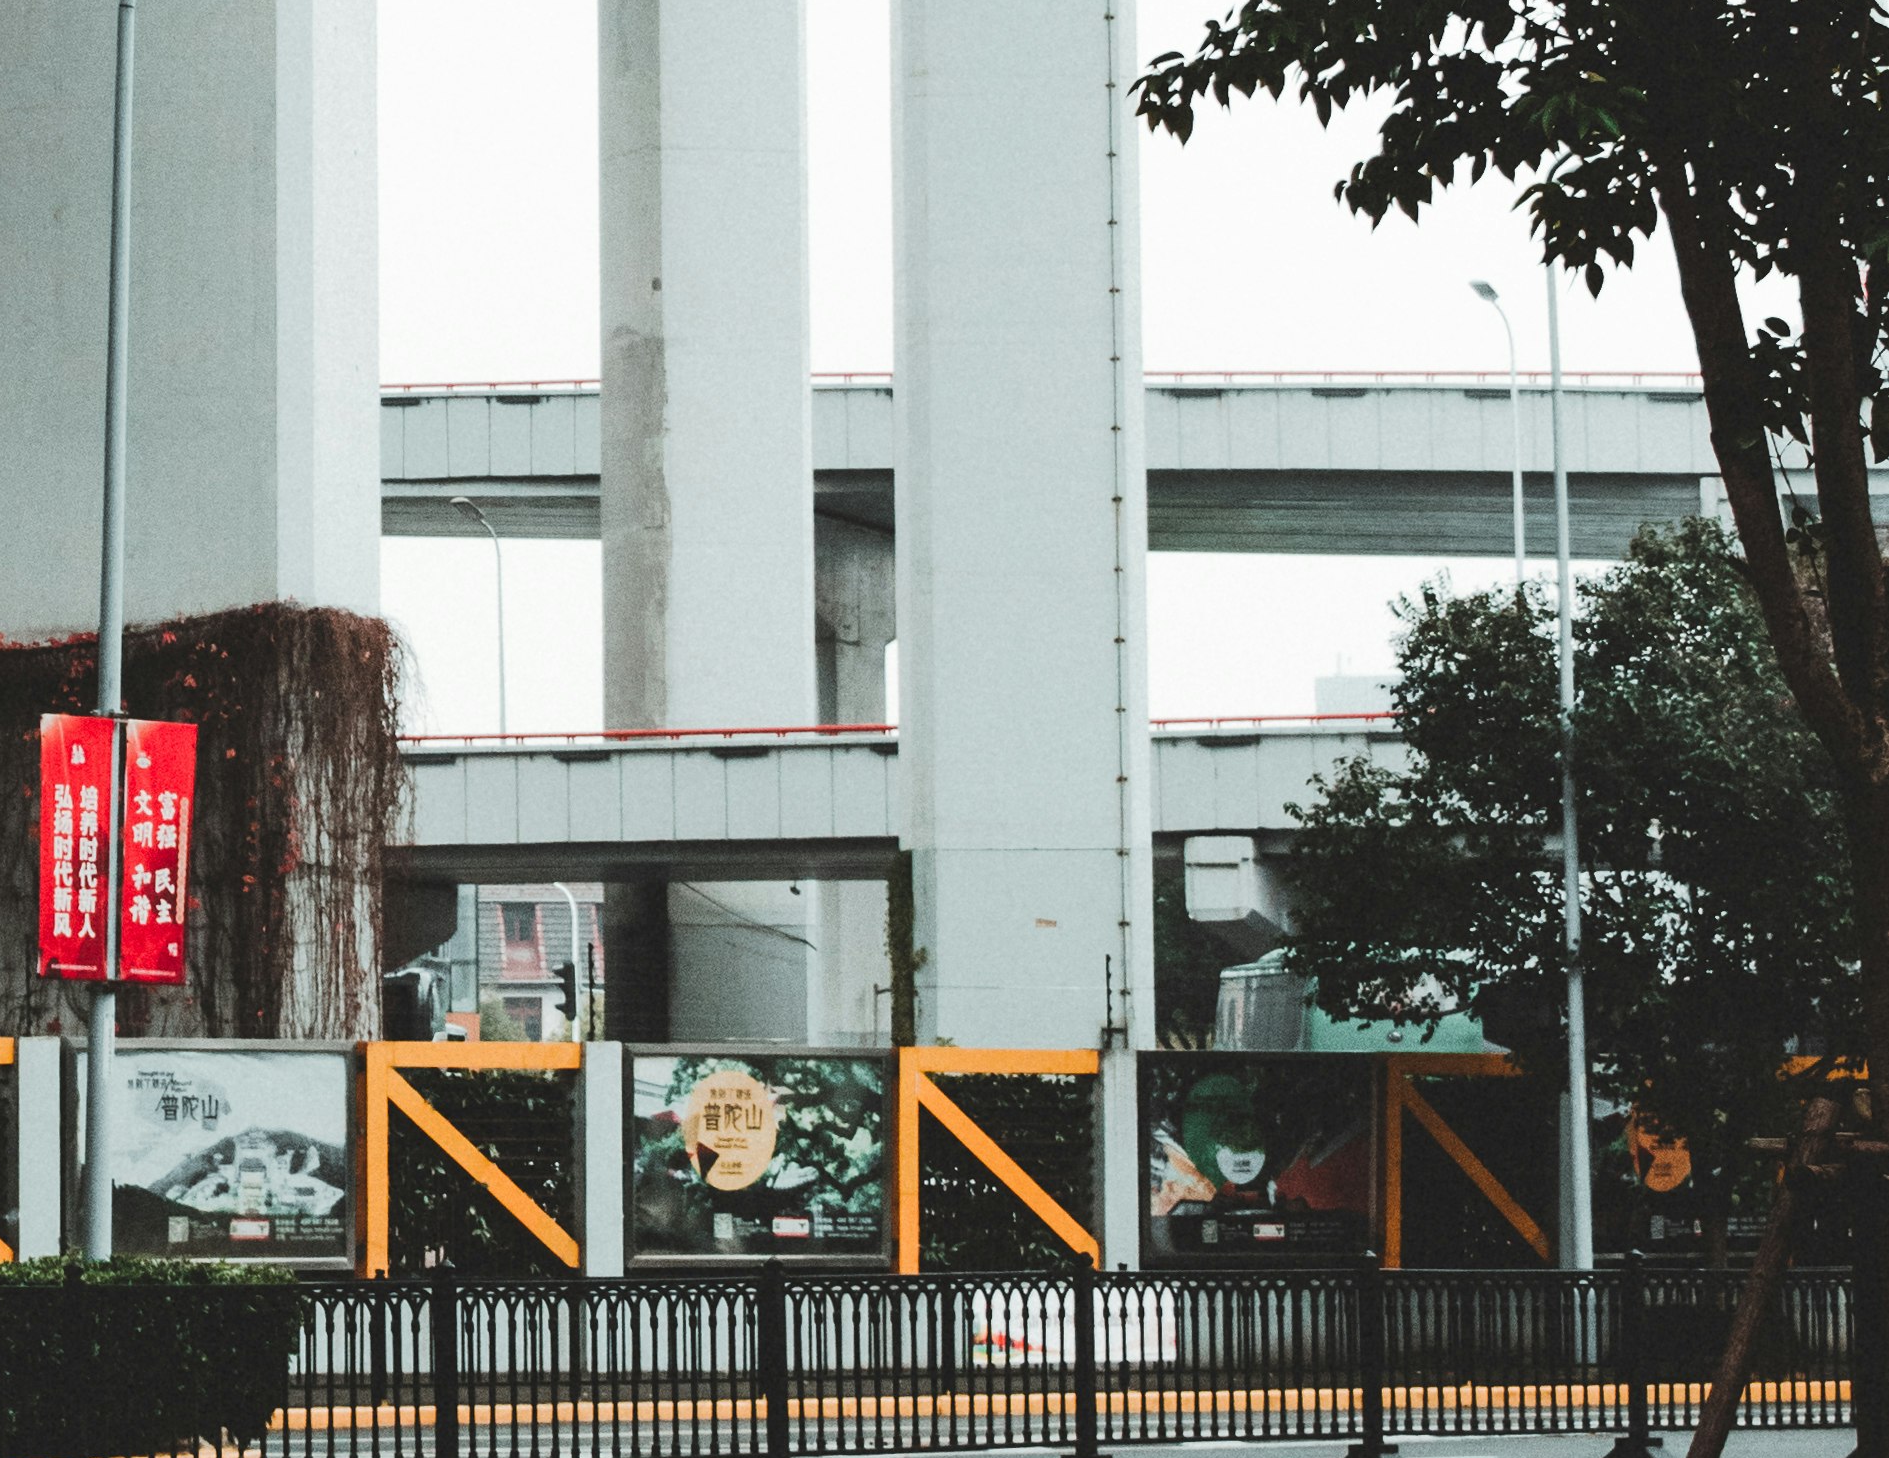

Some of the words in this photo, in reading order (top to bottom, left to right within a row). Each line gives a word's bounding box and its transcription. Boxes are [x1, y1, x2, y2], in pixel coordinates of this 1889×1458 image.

[132, 789, 153, 848] 文明
[157, 790, 178, 850] 富强
[53, 784, 73, 937] 弘扬时代新风
[78, 785, 98, 938] 培养时代新人
[129, 863, 151, 925] 和谐
[155, 868, 175, 924] 民主
[161, 1094, 219, 1121] 普陀山
[703, 1103, 763, 1132] 普陀山
